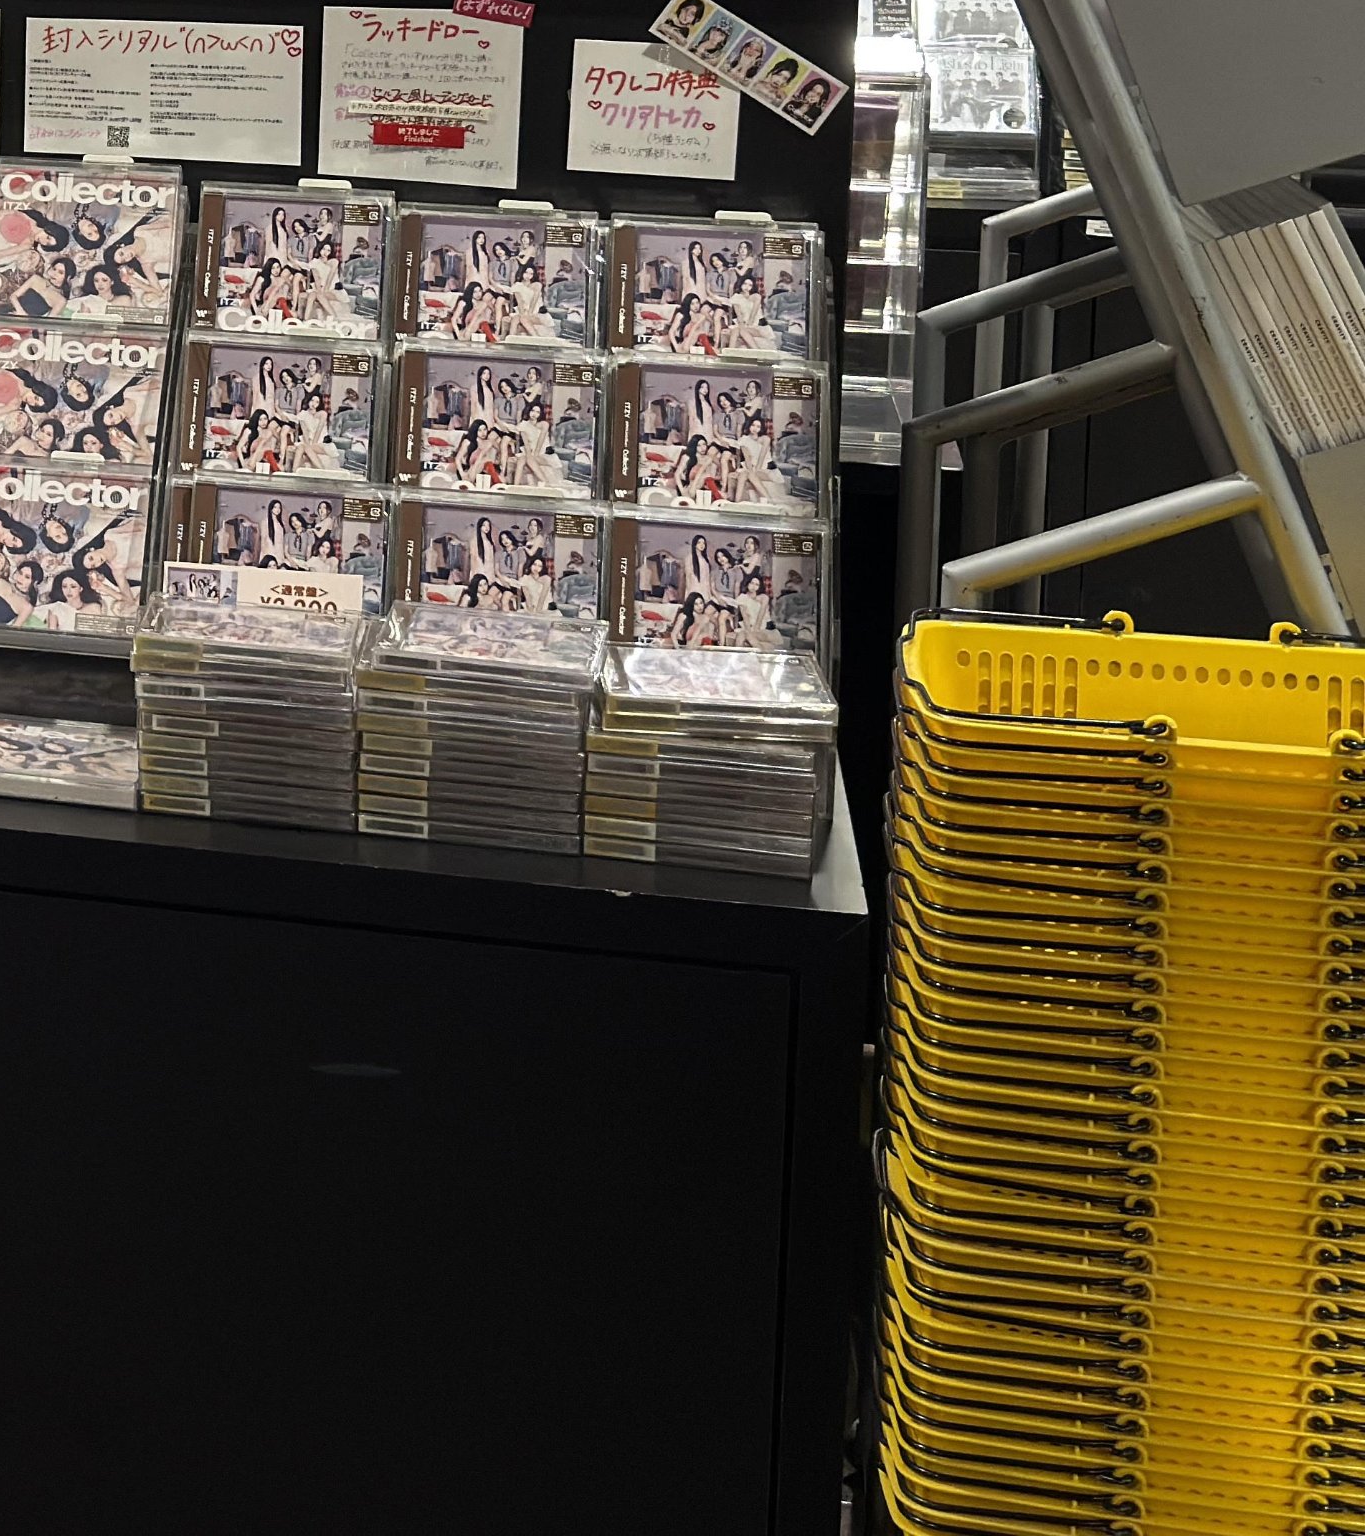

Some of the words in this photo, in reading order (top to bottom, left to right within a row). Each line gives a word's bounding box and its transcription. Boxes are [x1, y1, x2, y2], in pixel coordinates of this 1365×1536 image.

[362, 13, 480, 42] ラッキードロー
[585, 66, 720, 100] タワレコ特典
[601, 102, 702, 130] クリアトレカ
[1, 173, 175, 209] Collector
